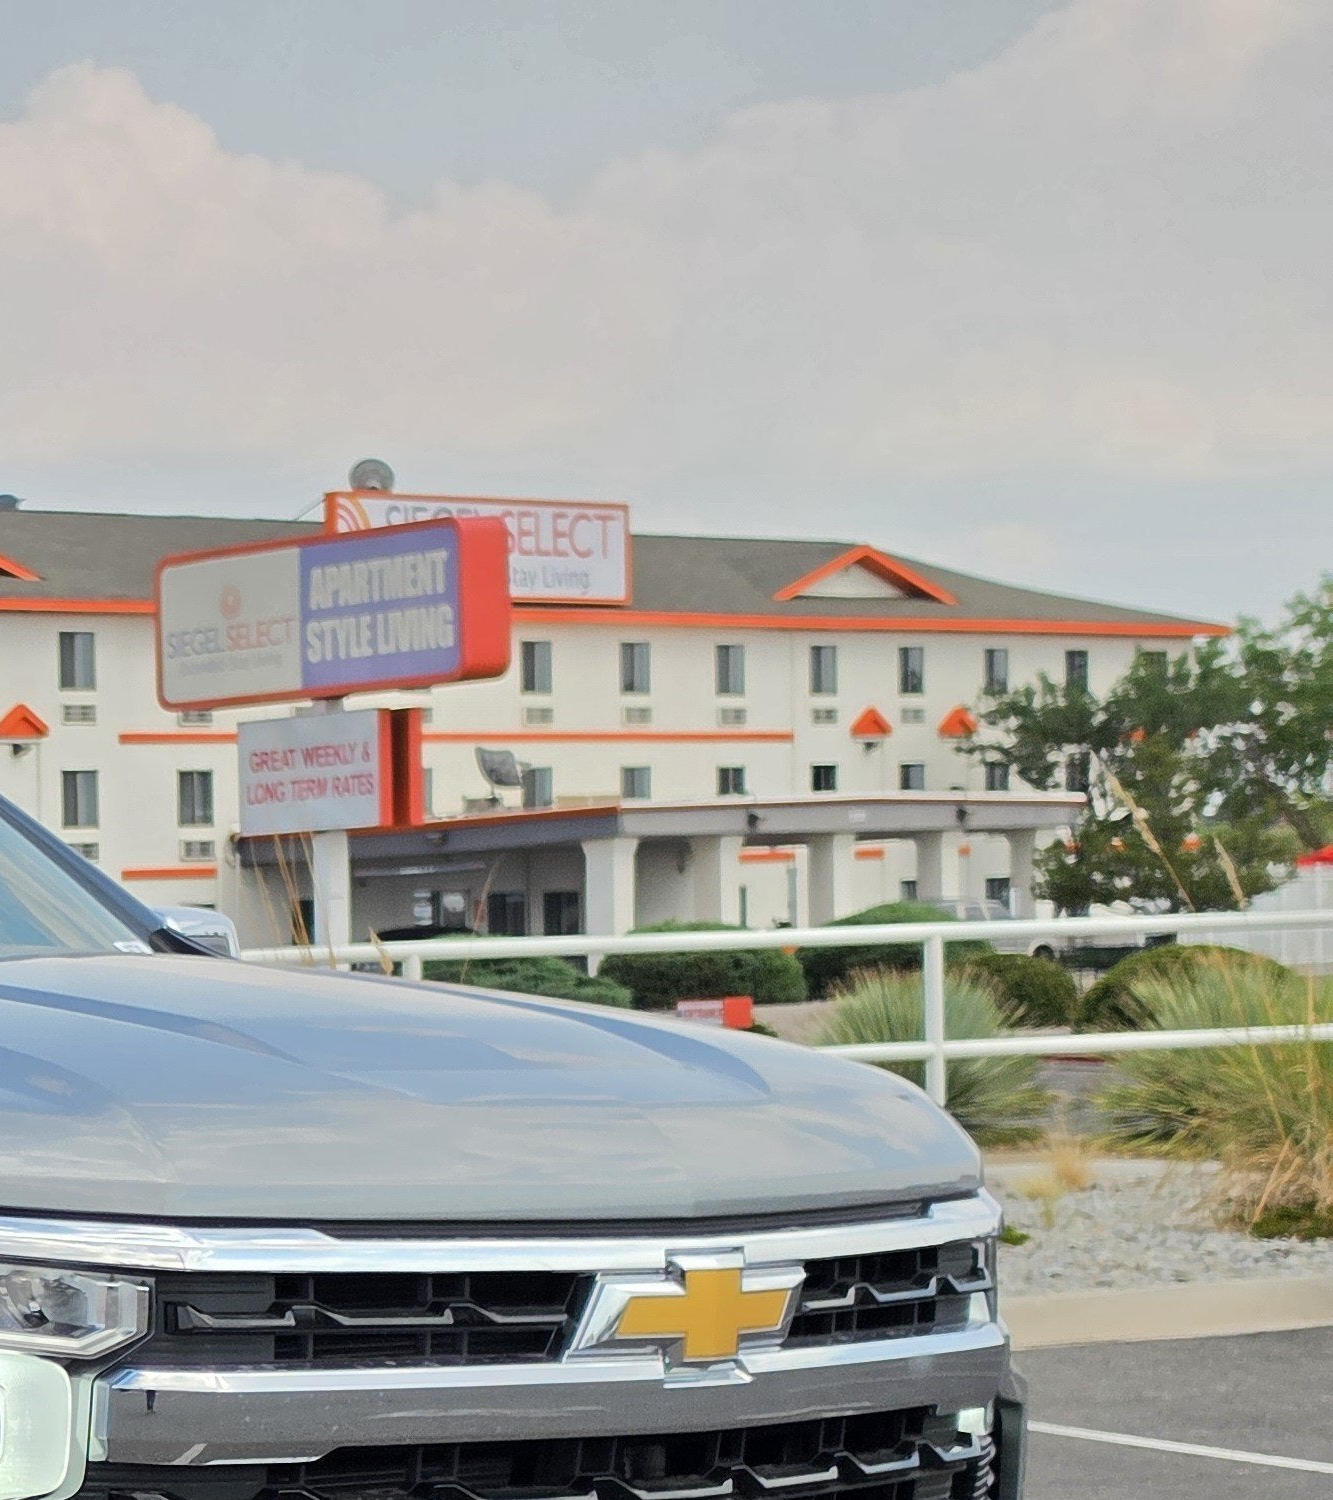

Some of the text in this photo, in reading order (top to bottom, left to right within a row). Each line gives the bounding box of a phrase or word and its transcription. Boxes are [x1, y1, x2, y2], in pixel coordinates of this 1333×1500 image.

[310, 549, 448, 610] APARTMENT
[306, 603, 454, 664] STYLE LIVING
[249, 748, 297, 774] GREAT
[301, 741, 357, 769] WEEKLY
[247, 773, 375, 806] LONG TERM RATES
